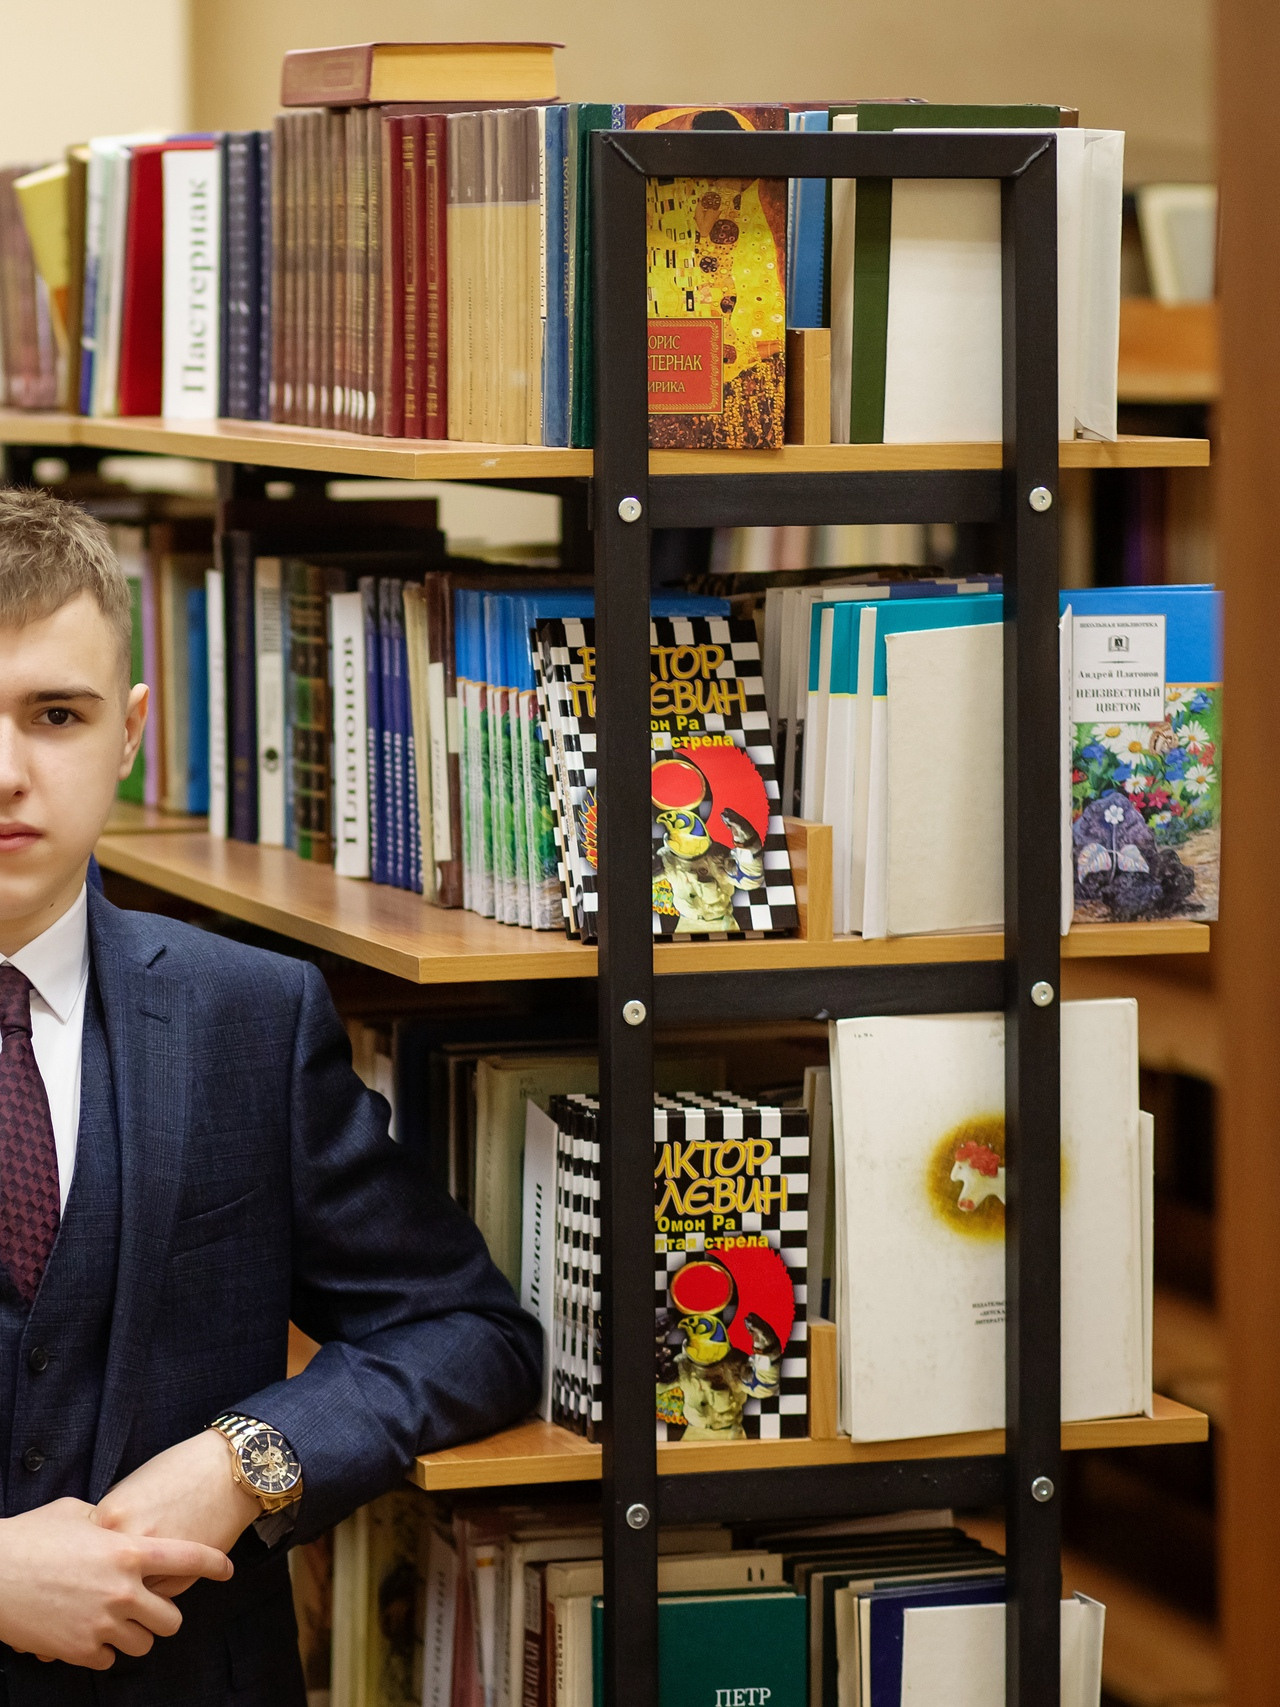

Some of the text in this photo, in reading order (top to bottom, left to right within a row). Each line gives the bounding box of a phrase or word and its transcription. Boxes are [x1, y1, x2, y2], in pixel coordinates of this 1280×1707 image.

[182, 178, 213, 392] Пастернак
[648, 335, 681, 350] ОРИС
[648, 354, 703, 371] ТЕРНАК
[648, 381, 686, 393] ИРИКА
[1079, 670, 1159, 680] Андрей Платонов
[1076, 687, 1160, 698] НЕИЗВЕСТНЫЙ
[1096, 702, 1141, 713] ЦВЕТОК
[651, 715, 700, 732] он Ра
[671, 734, 735, 751] стрела
[654, 1137, 773, 1180] ИКТОР
[654, 1175, 788, 1221] ЛЕВИН
[657, 1214, 736, 1233] Омон Ра
[655, 1234, 769, 1252] лтая стрела
[715, 1687, 772, 1707] ПЕТР
